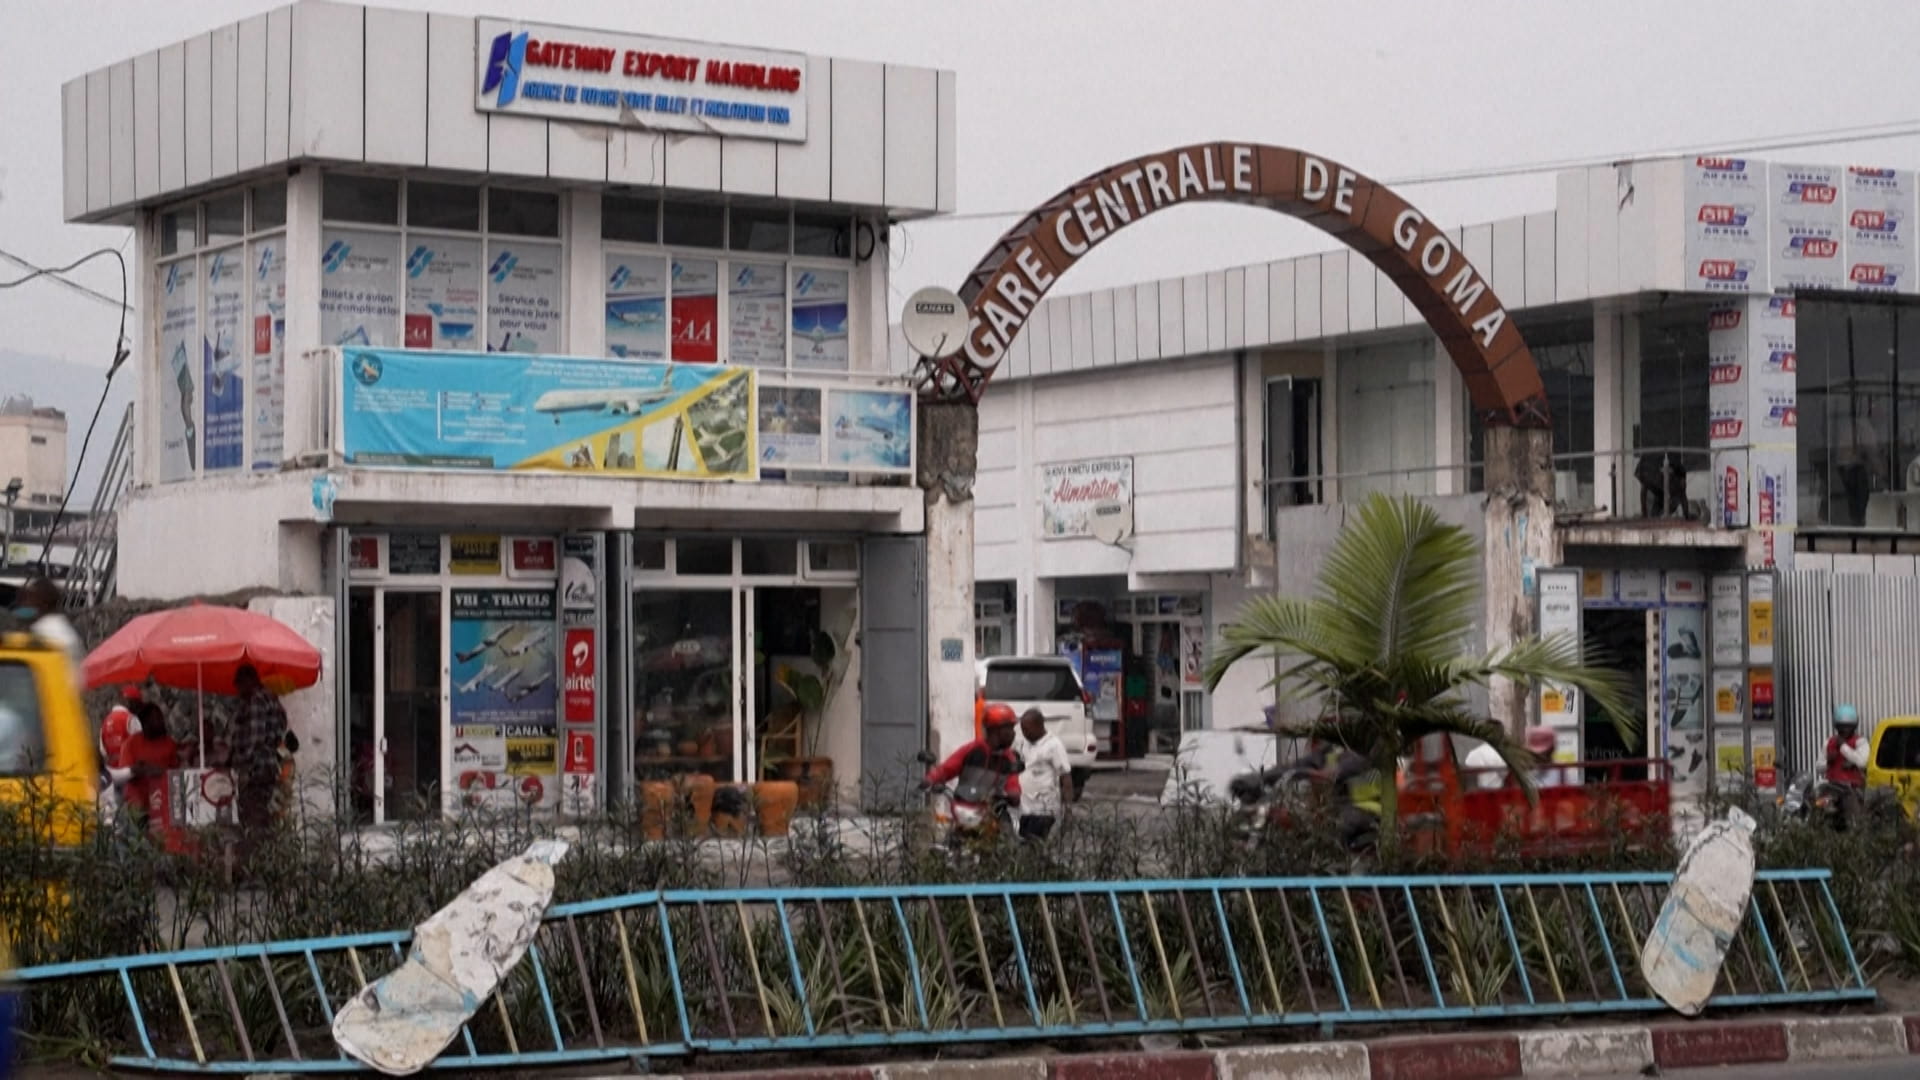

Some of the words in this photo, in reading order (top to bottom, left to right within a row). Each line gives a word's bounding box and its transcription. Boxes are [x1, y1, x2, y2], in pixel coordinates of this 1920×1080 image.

[526, 39, 616, 74] GATEWAY
[623, 50, 701, 82] EXPORT
[705, 59, 801, 92] HANDLING
[522, 81, 563, 101] AGENCE
[563, 85, 578, 103] DE
[963, 247, 1055, 369] GARE
[1056, 145, 1253, 257] CENTRALE
[1303, 156, 1357, 215] DE
[1392, 208, 1508, 349] GOMA
[499, 294, 534, 305] Service
[499, 320, 522, 331] pour
[1091, 461, 1121, 474] EXPRESS
[1053, 477, 1120, 504] Alimentation
[491, 592, 550, 606] TRAVELS
[565, 672, 595, 690] airtel
[506, 725, 545, 737] CANAL
